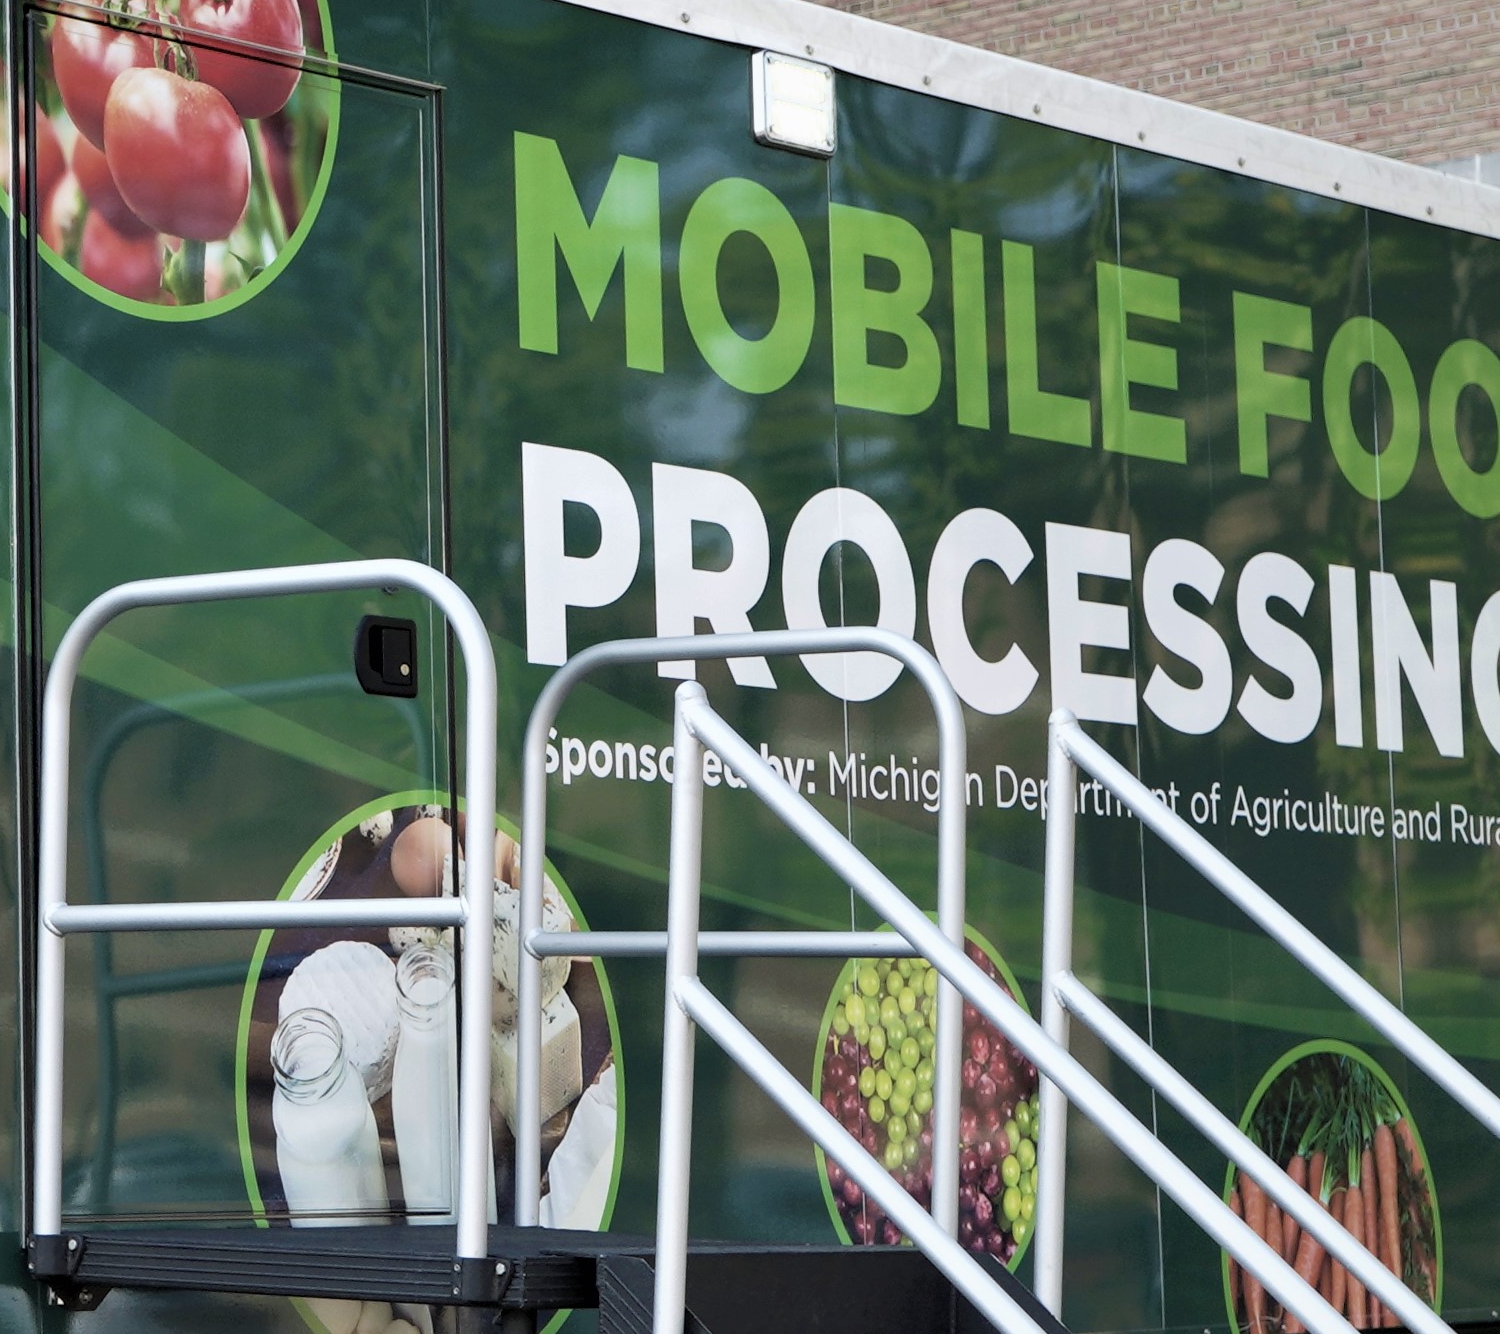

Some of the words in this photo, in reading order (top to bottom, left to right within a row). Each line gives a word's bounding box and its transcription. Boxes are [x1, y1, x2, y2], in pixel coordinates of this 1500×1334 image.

[513, 130, 1188, 465] MOBILE
[545, 726, 748, 789] Sponsoe
[828, 750, 984, 813] Michign
[995, 764, 1181, 821] Deprtt
[1190, 781, 1222, 825] of
[1230, 785, 1385, 837] Agriculture
[1392, 801, 1442, 842] and
